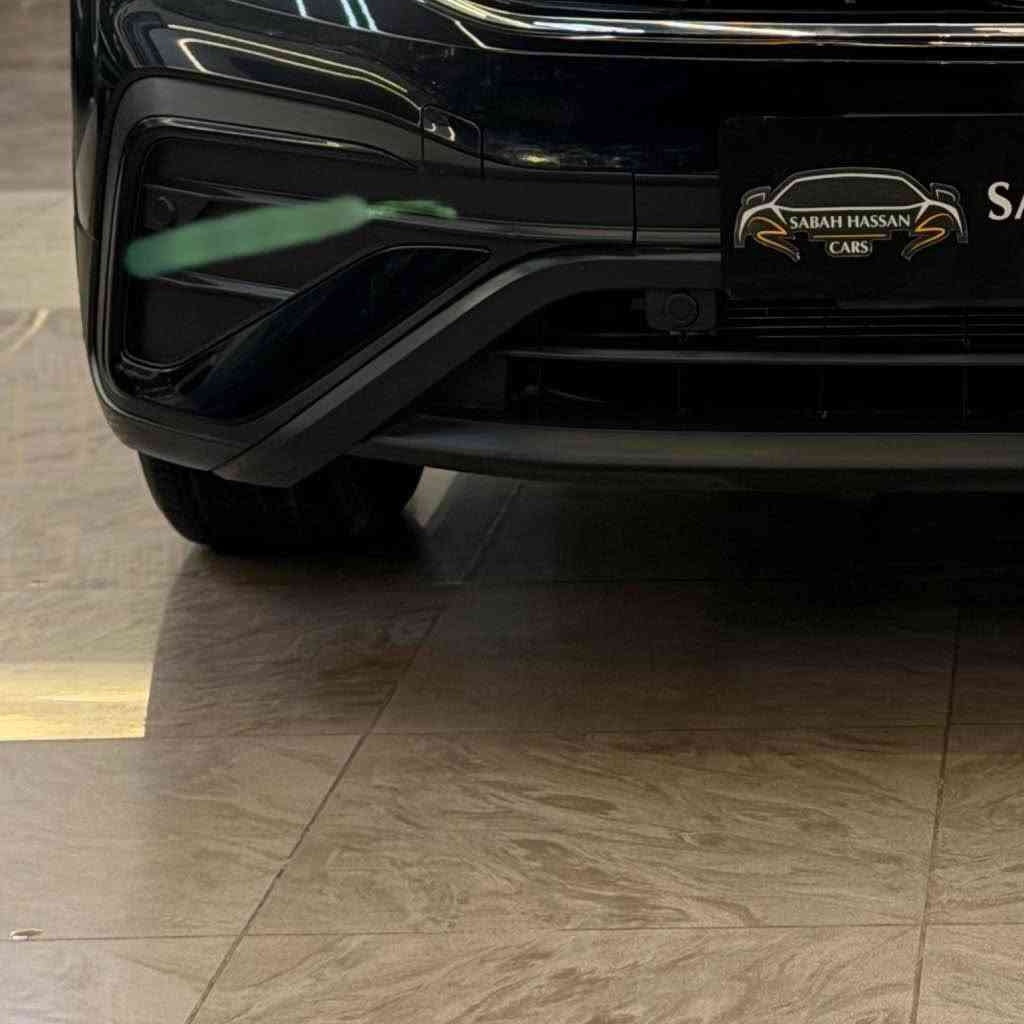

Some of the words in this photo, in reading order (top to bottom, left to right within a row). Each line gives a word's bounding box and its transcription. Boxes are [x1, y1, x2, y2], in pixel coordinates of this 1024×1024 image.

[789, 215, 843, 231] SABAH
[847, 213, 912, 229] HASSAN
[828, 240, 870, 256] CARS
